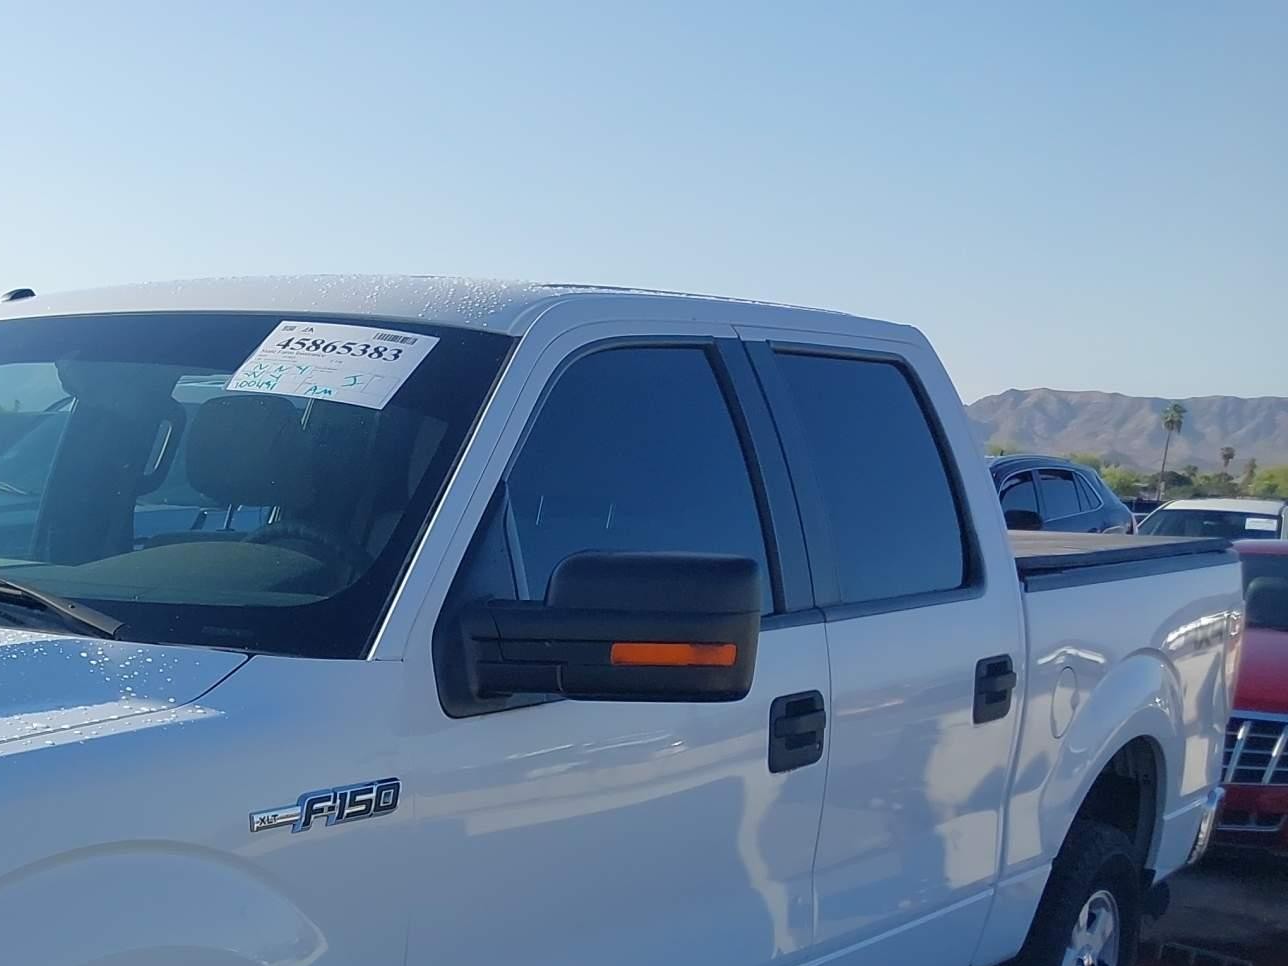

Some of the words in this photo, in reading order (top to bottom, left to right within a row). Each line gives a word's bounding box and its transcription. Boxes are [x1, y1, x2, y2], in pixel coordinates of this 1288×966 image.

[276, 336, 404, 363] 45865383
[258, 813, 280, 827] XLT
[294, 777, 402, 831] F-150
